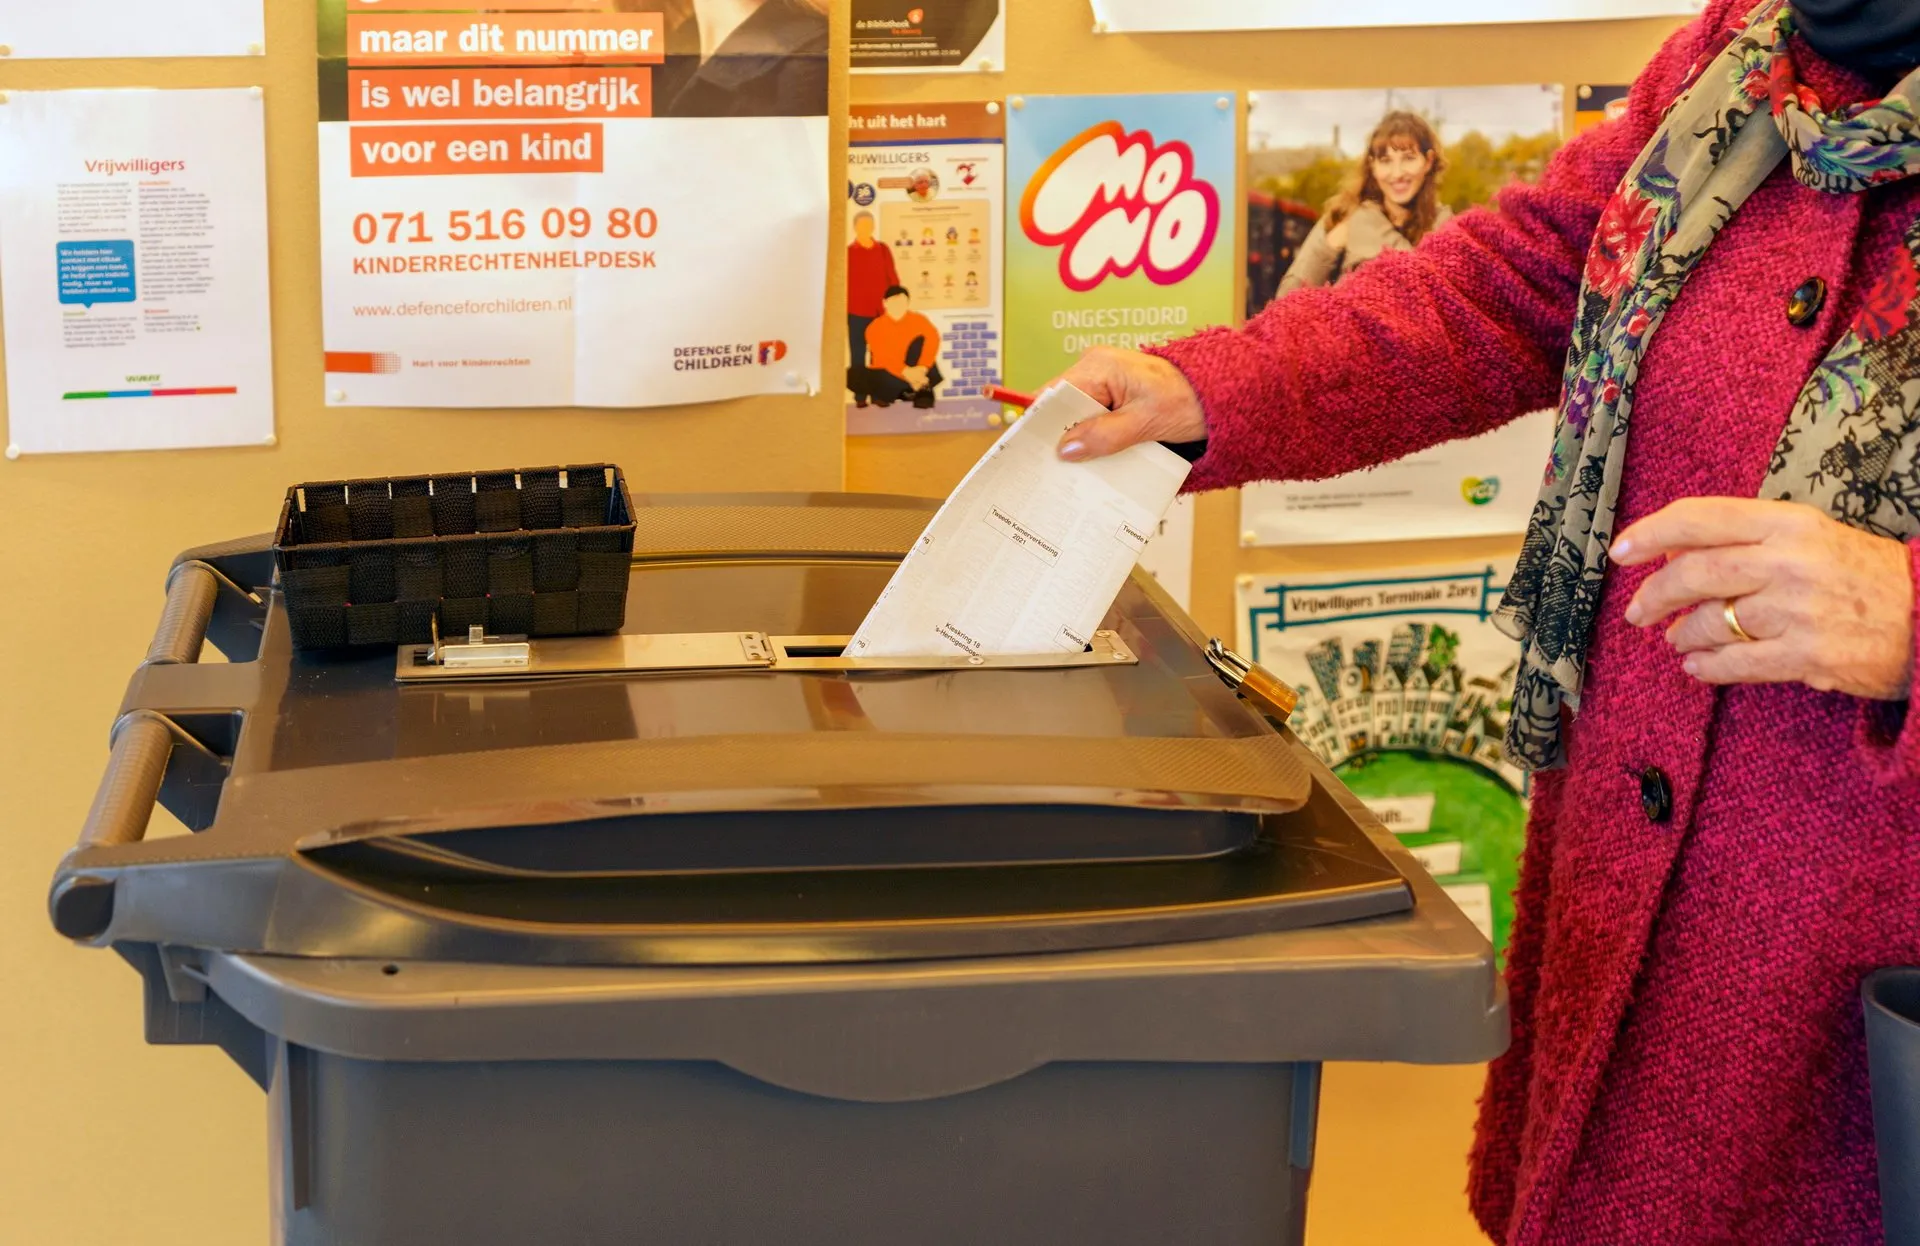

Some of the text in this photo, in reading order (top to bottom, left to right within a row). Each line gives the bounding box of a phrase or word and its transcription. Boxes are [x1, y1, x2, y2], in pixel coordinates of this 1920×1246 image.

[359, 23, 654, 53] maar dit nummer
[361, 76, 640, 111] is wel belangrijk
[866, 114, 888, 128] uit
[890, 114, 914, 128] het
[916, 113, 947, 128] hart
[362, 132, 592, 164] voor een kind
[84, 158, 185, 176] Vrijwilligers
[352, 207, 658, 244] 071 516 09 80
[352, 251, 657, 274] KINDERRECHTENHELPDESK
[353, 296, 573, 317] www.defenceforchildren.nl
[1052, 306, 1188, 329] ONGESTOORD
[674, 344, 754, 357] DEFENCE for
[412, 360, 434, 368] Hart
[462, 358, 530, 366] Kinderrechten
[674, 354, 752, 371] CHILDREN
[992, 508, 1059, 558] Tweede Kamerverkiezing
[1012, 532, 1027, 545] 2021
[1123, 524, 1144, 541] Tweede
[1292, 582, 1477, 614] Vrijwilligers Terminale Zorg
[946, 622, 981, 650] Kieskring 18
[1062, 628, 1084, 646] Tweede
